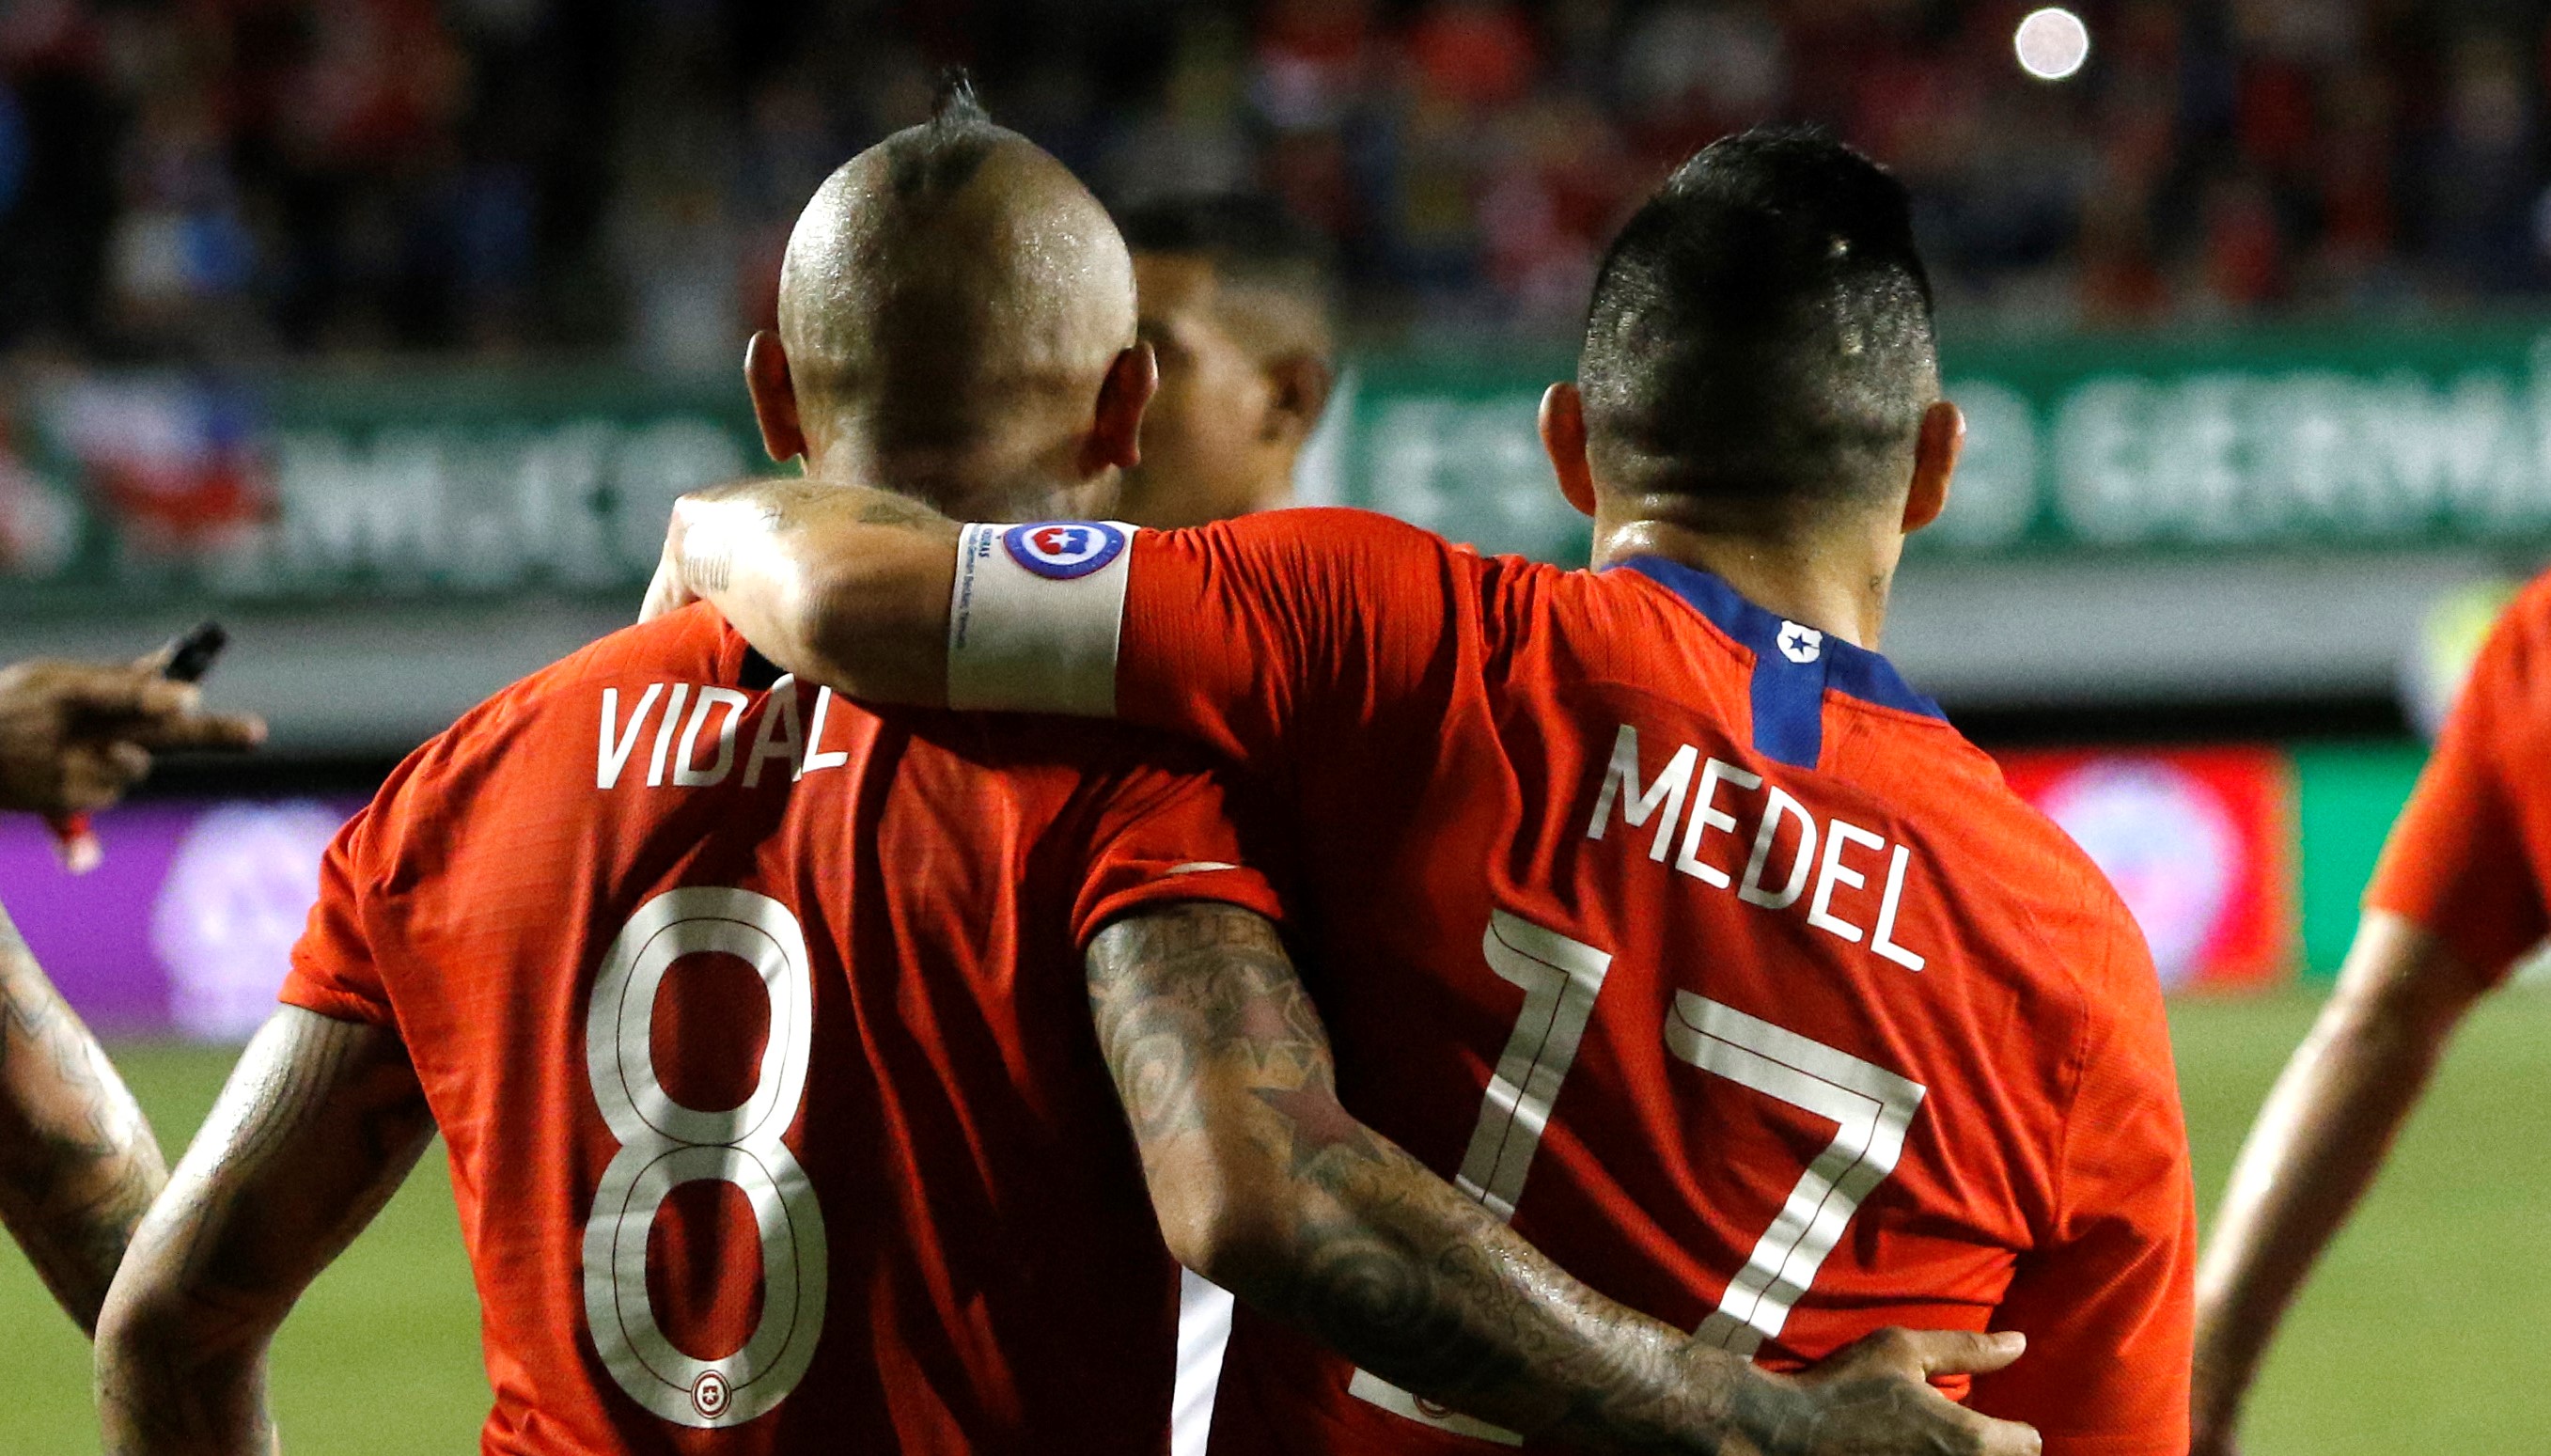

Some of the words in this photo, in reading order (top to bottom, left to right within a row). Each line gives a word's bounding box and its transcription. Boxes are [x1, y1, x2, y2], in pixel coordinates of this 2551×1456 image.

[596, 673, 850, 790] VIDAL
[1587, 724, 1926, 972] MEDEL
[583, 886, 828, 1429] 8
[1348, 908, 1927, 1446] 17
